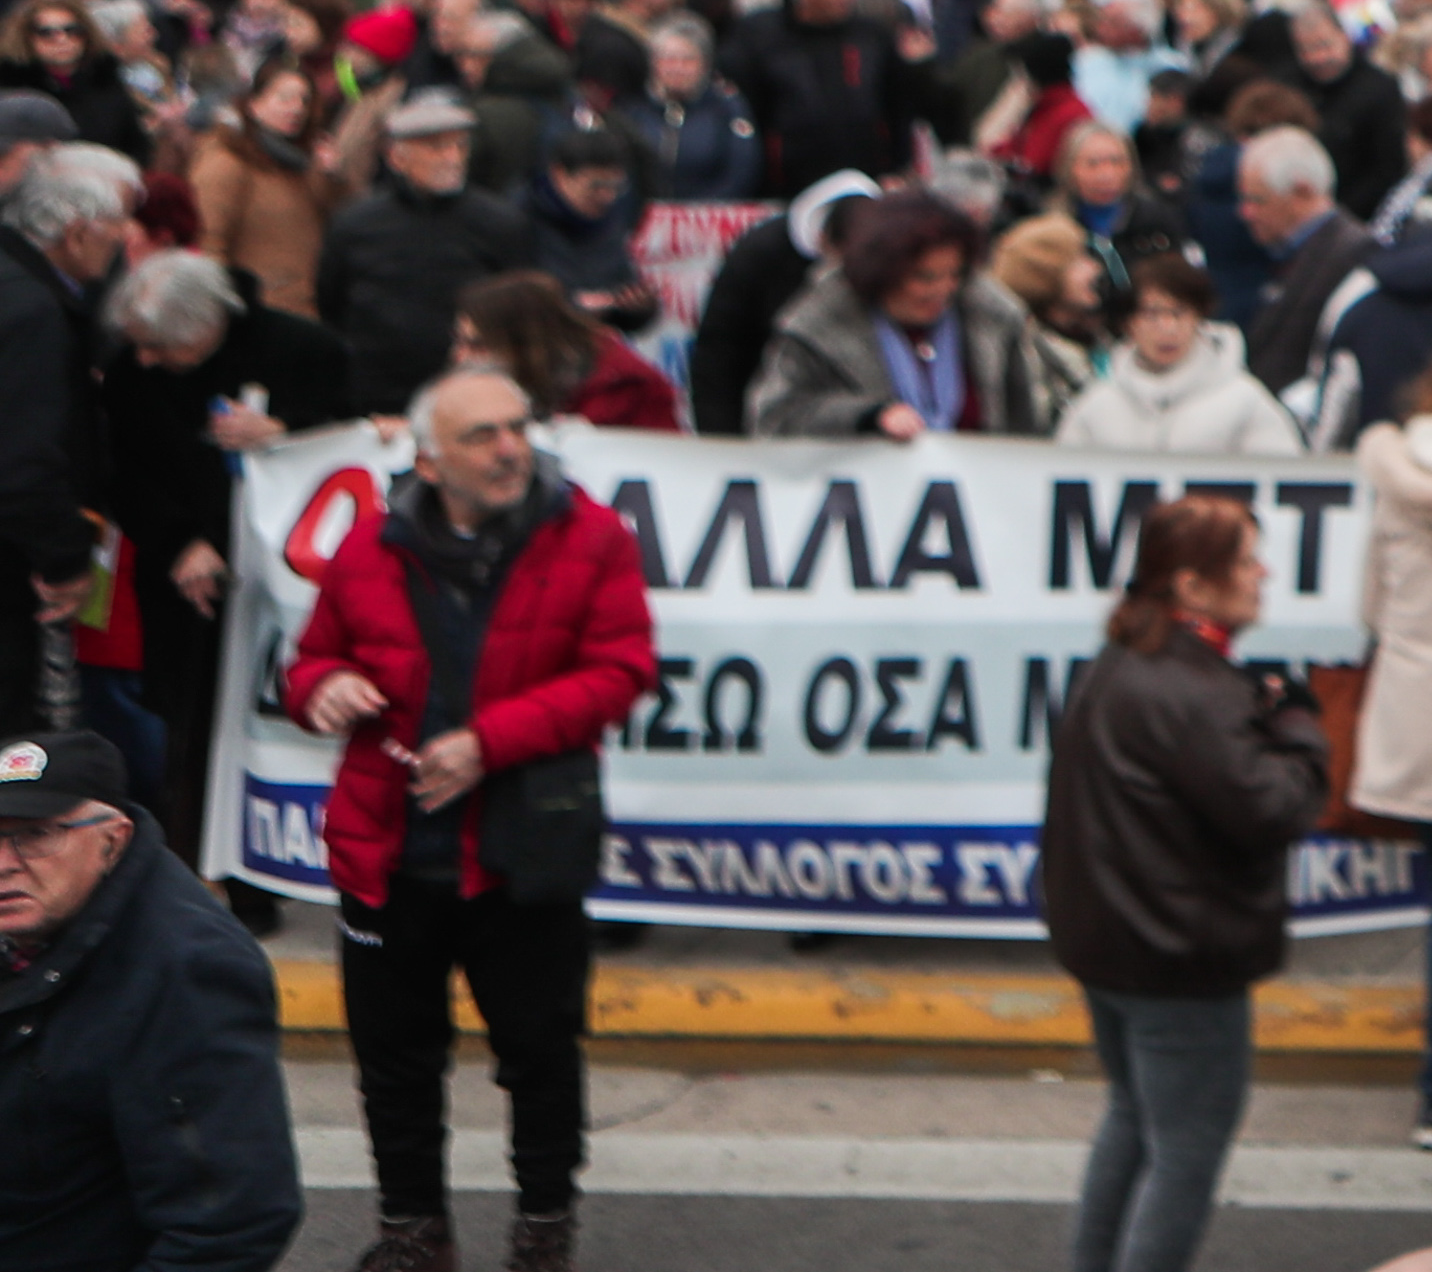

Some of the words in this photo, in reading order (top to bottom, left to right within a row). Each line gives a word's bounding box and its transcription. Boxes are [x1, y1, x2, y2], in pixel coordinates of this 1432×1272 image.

[804, 657, 980, 752] ΟΣΑ
[643, 833, 948, 905] ΣΥΛΛΟΓΟΣ
[955, 841, 1042, 907] ΣΥ
